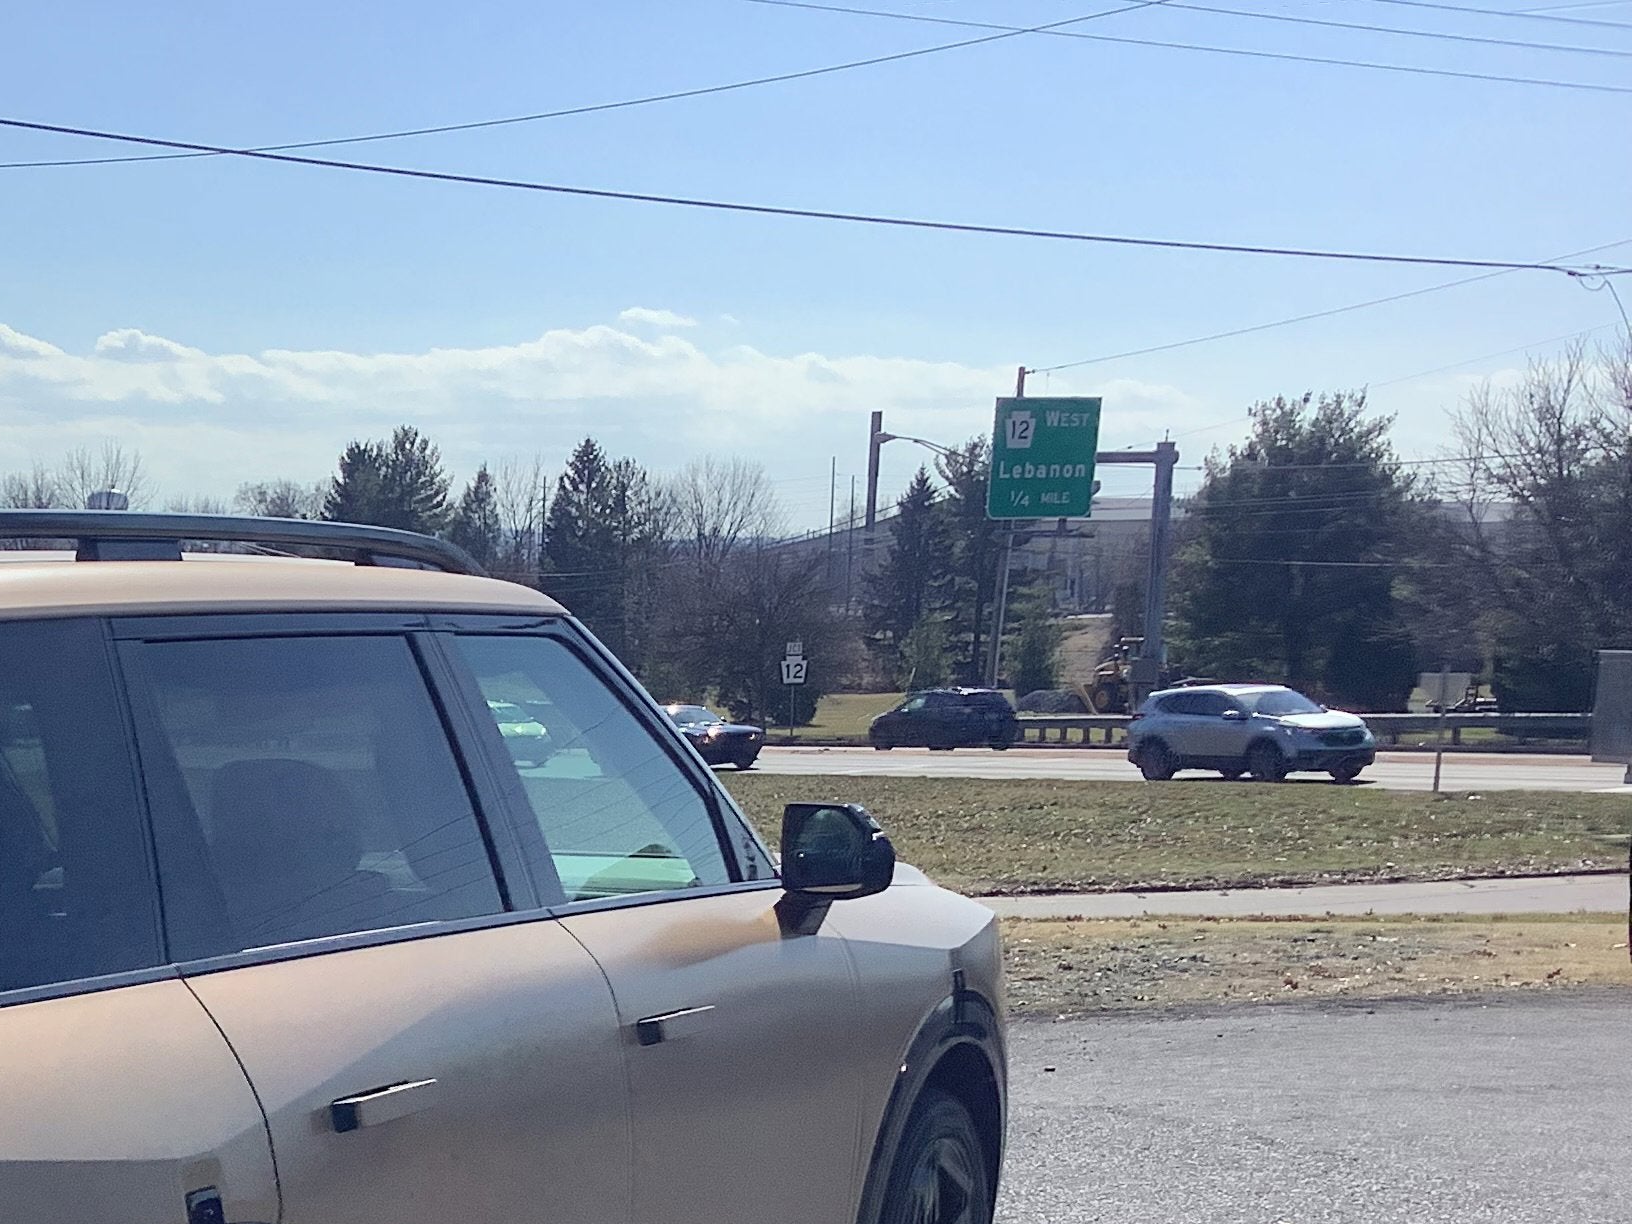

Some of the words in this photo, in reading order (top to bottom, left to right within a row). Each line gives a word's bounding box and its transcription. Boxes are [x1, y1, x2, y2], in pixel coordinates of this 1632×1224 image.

[1045, 410, 1090, 427] WEST
[1010, 419, 1030, 440] 12
[998, 461, 1086, 479] Lebanon
[1040, 492, 1070, 504] MILE
[785, 663, 804, 679] 12
